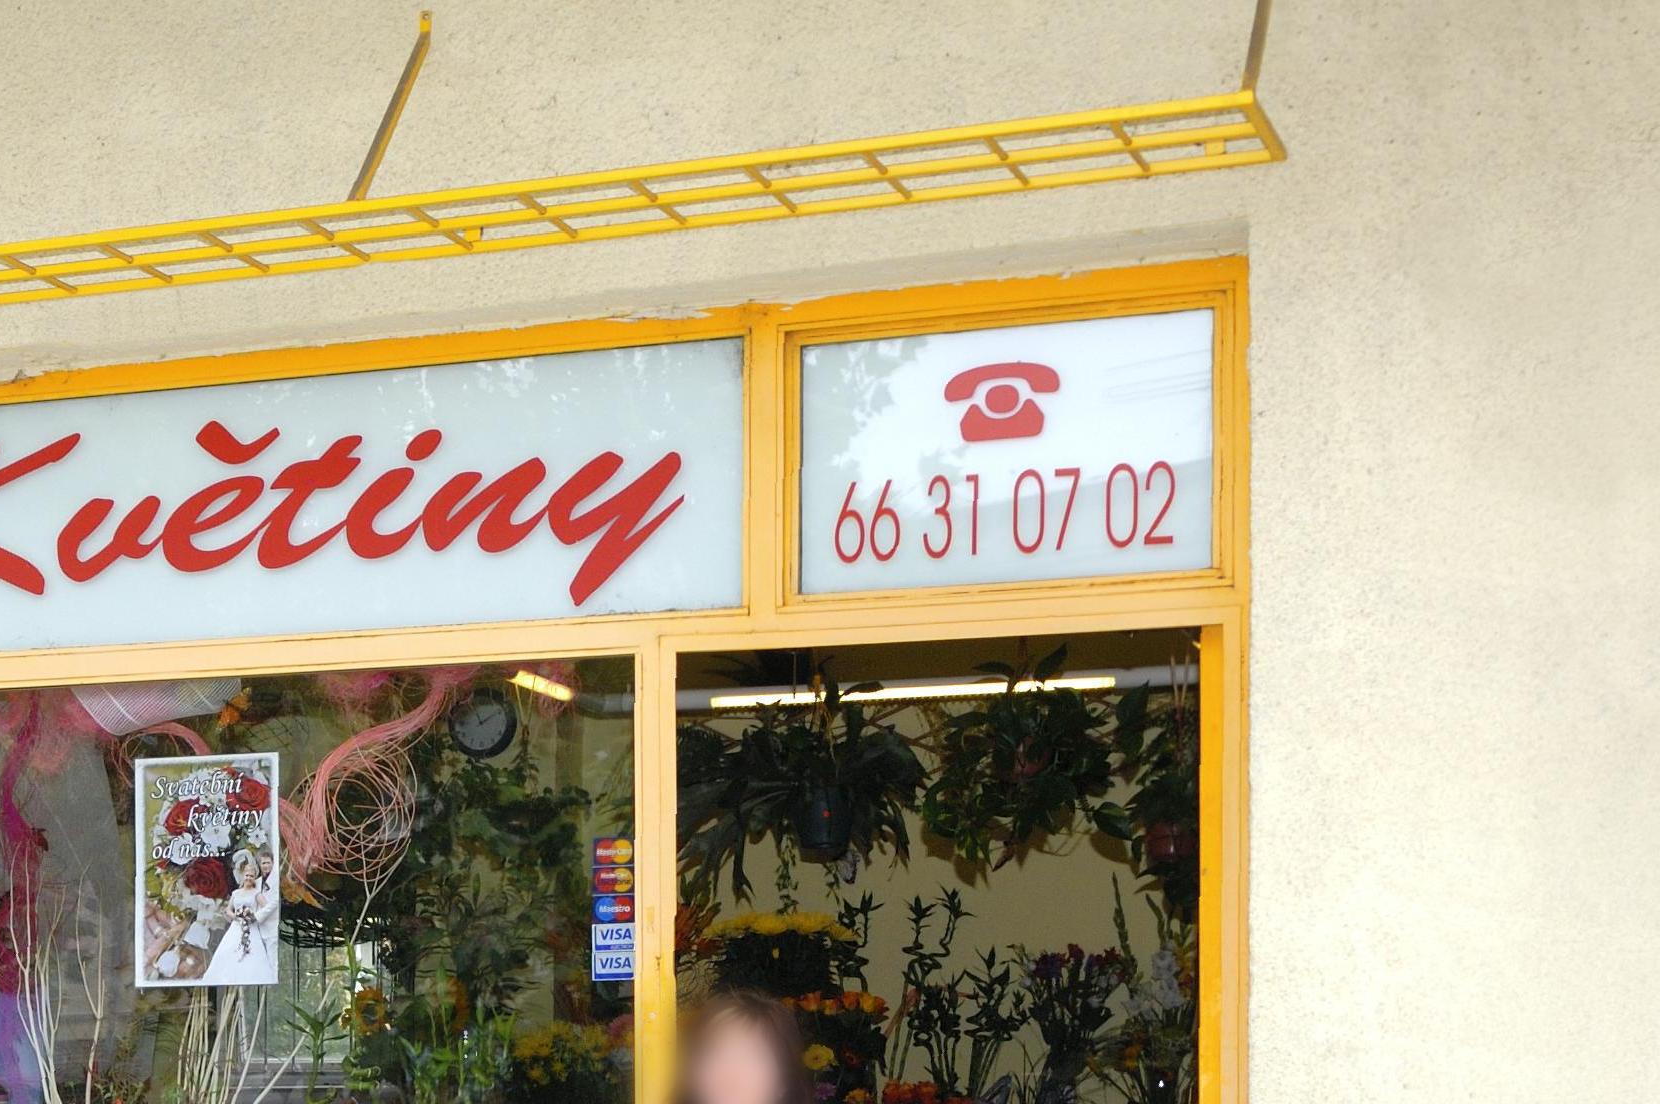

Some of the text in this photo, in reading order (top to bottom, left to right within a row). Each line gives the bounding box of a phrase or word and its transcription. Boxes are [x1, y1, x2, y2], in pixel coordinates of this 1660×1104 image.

[834, 460, 1176, 565] 66 31 07 02
[151, 771, 244, 799] Svatební
[187, 804, 263, 832] květiny
[152, 838, 178, 859] od
[600, 928, 632, 940] VISA
[599, 957, 632, 969] VISA
